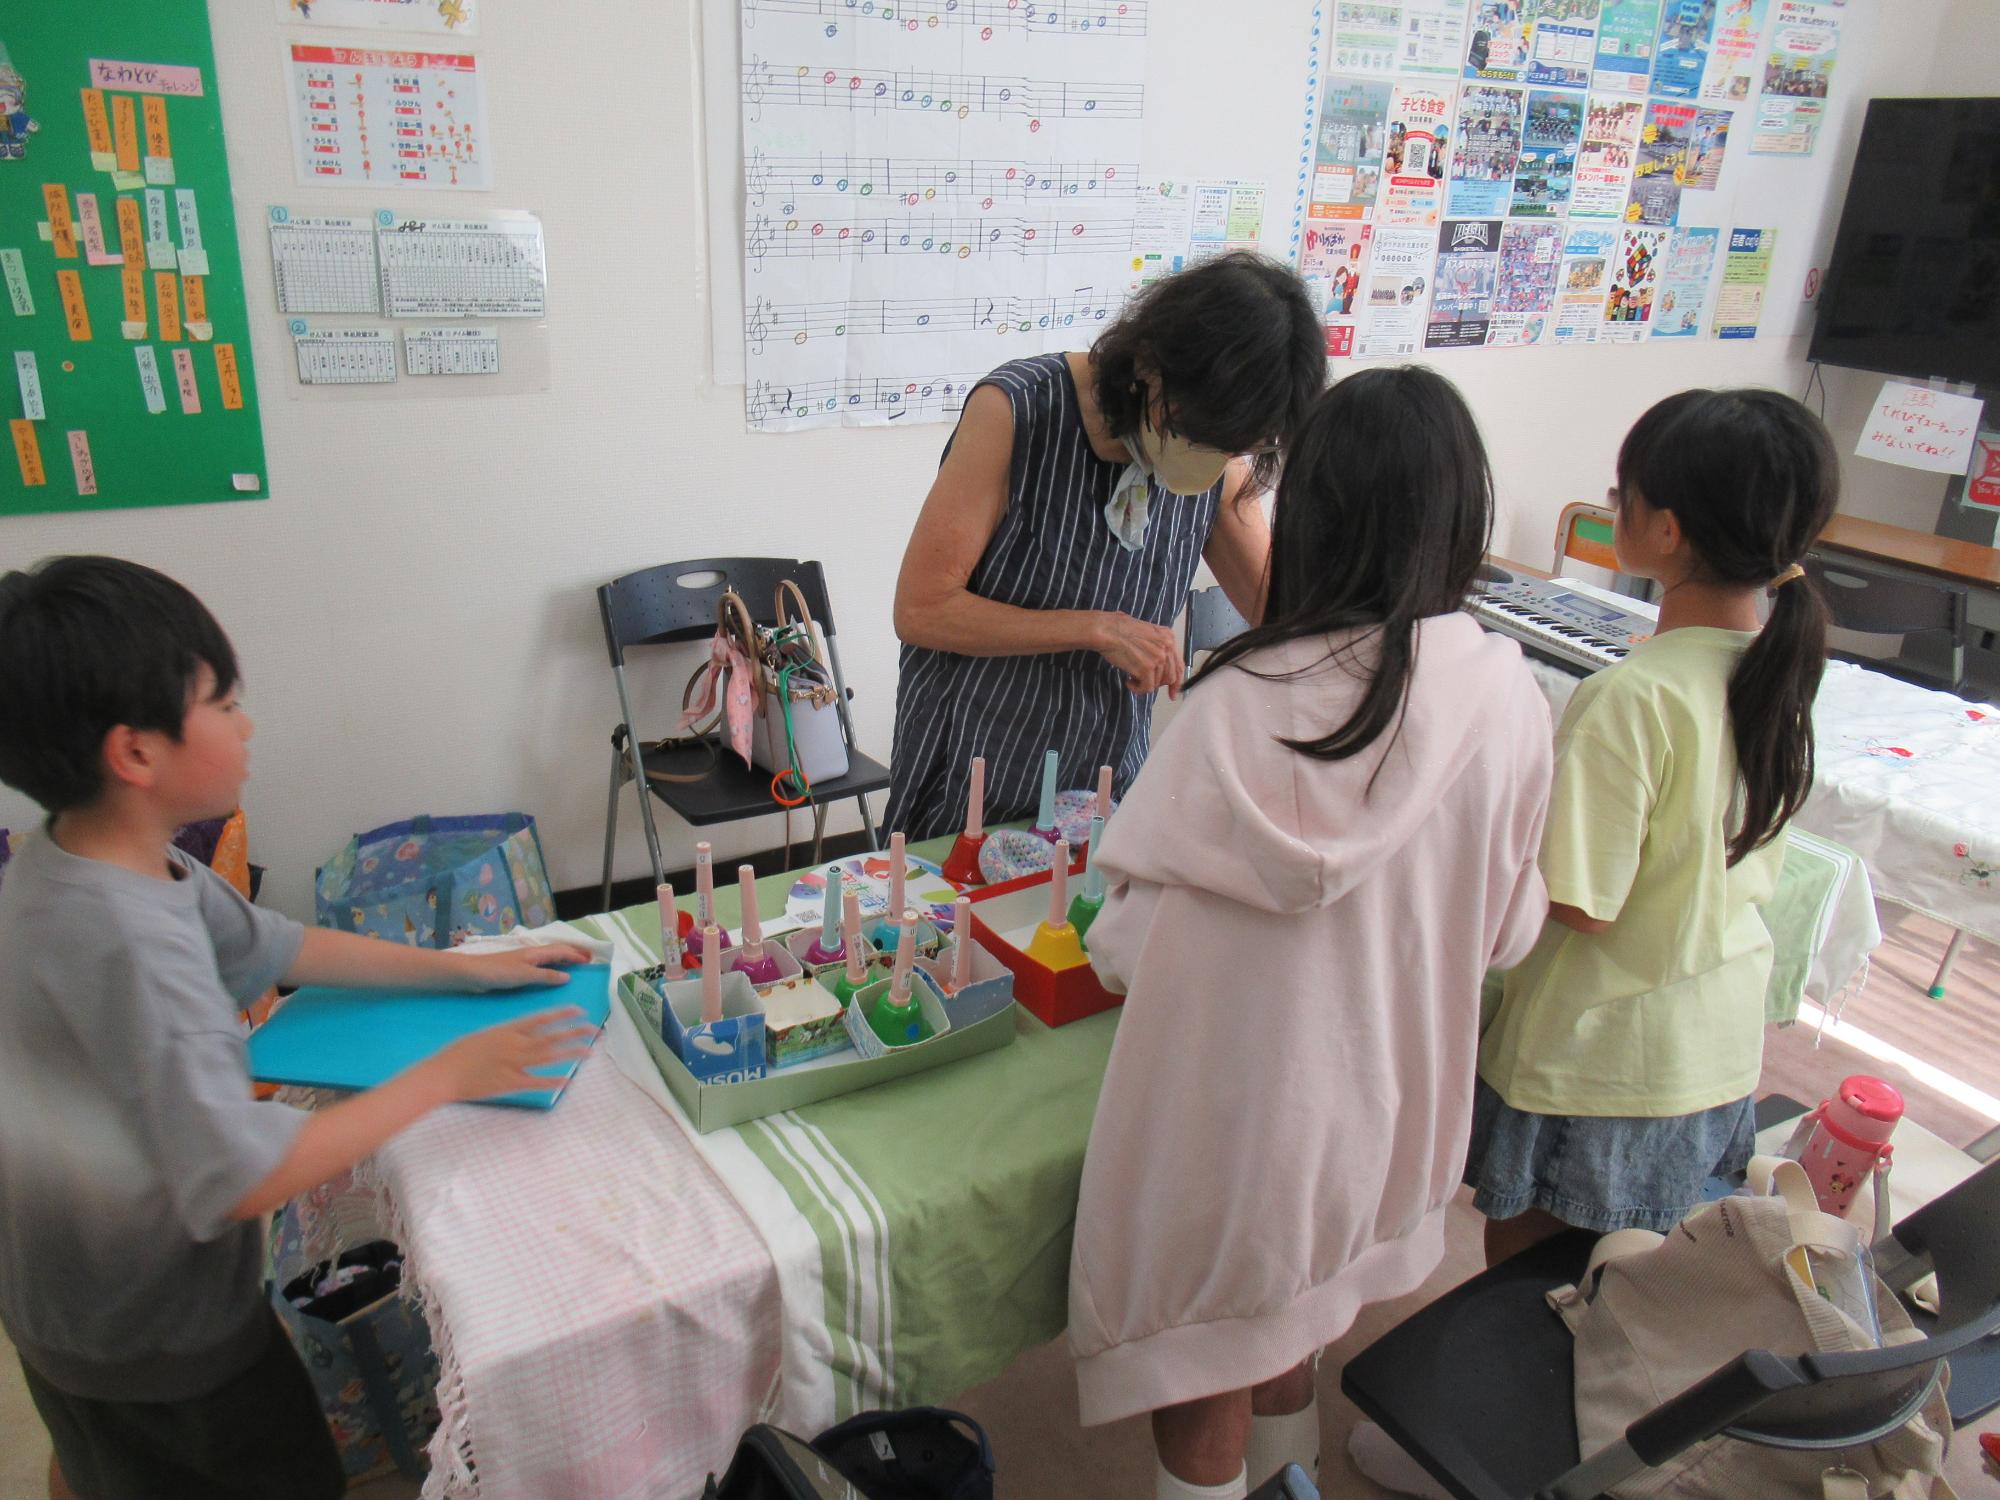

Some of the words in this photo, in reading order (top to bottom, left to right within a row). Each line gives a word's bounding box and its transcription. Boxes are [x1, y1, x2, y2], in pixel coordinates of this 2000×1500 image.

[98, 63, 159, 84] なわとび
[1401, 97, 1446, 116] 子ども食堂
